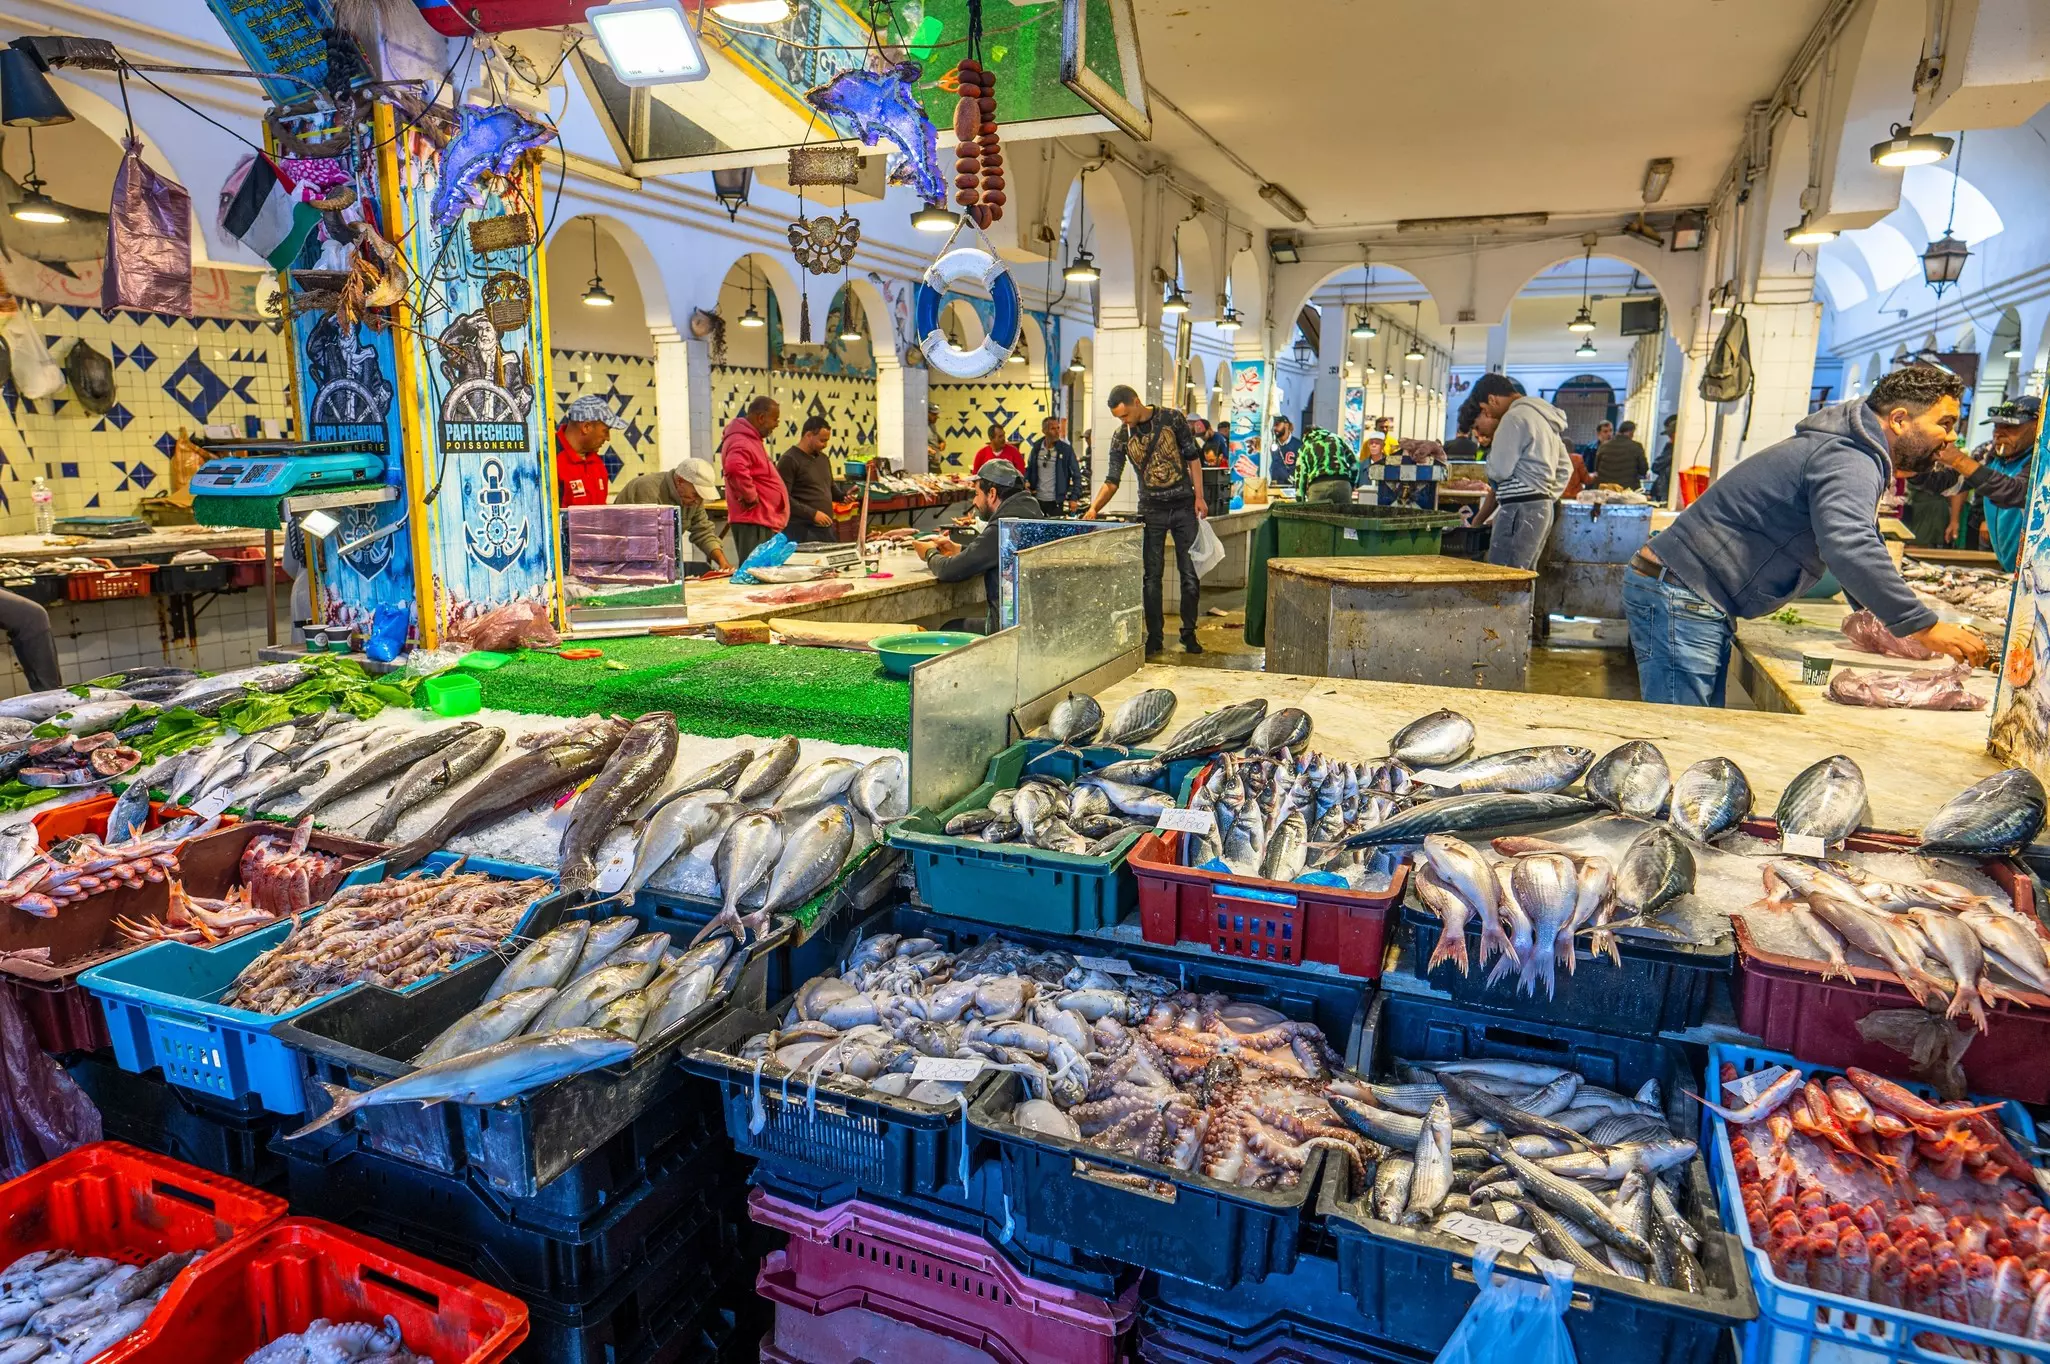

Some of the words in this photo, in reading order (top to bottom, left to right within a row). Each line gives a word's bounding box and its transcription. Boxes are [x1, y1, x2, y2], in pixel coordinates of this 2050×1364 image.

[314, 425, 338, 442] PAPI
[338, 424, 384, 443] PECHEUR
[445, 424, 472, 442] PAPI
[473, 423, 524, 442] PECHEUR
[316, 443, 385, 452] POISSNERIE
[445, 441, 525, 450] POISSONERIE
[1285, 451, 1296, 465] C
